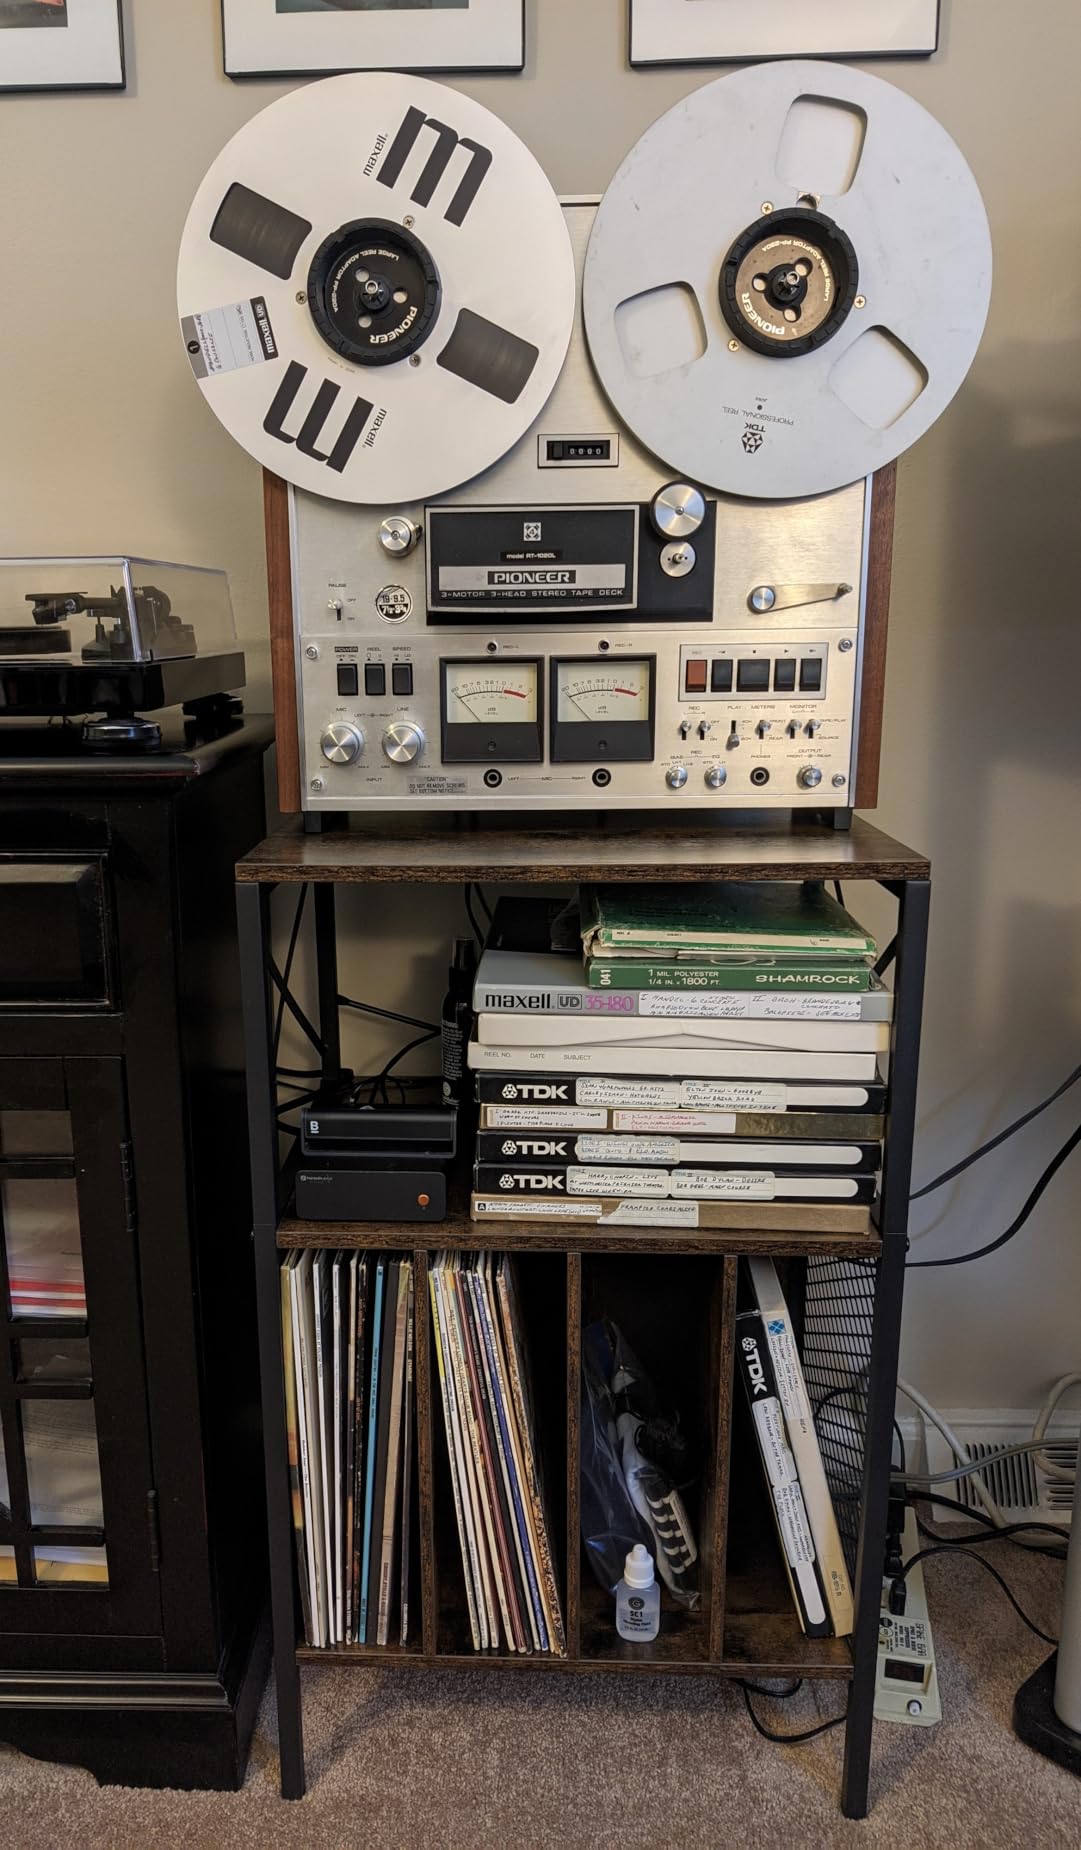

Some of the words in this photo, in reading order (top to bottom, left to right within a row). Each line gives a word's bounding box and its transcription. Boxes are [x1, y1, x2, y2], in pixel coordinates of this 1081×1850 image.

[363, 134, 387, 176] maxell
[360, 249, 377, 257] REEL
[378, 249, 399, 261] LARGE
[741, 292, 785, 335] PIONEER
[369, 306, 418, 344] PIONEER
[259, 316, 275, 353] maxell
[722, 406, 739, 415] REEL
[741, 409, 794, 426] PROFESSIONAL
[365, 408, 388, 448] maxell
[744, 422, 766, 432] TDK
[494, 572, 570, 584] PIONEER
[600, 970, 612, 985] 041
[680, 977, 708, 986] 1800
[756, 975, 860, 984] SHAMROCK
[485, 994, 551, 1009] maxell
[559, 996, 580, 1008] UD
[585, 995, 634, 1011] 35-180
[517, 1084, 568, 1100] TDK
[310, 1120, 320, 1131] B
[516, 1141, 568, 1156] TDK
[518, 1175, 565, 1190] TDK
[746, 1354, 768, 1395] TDK
